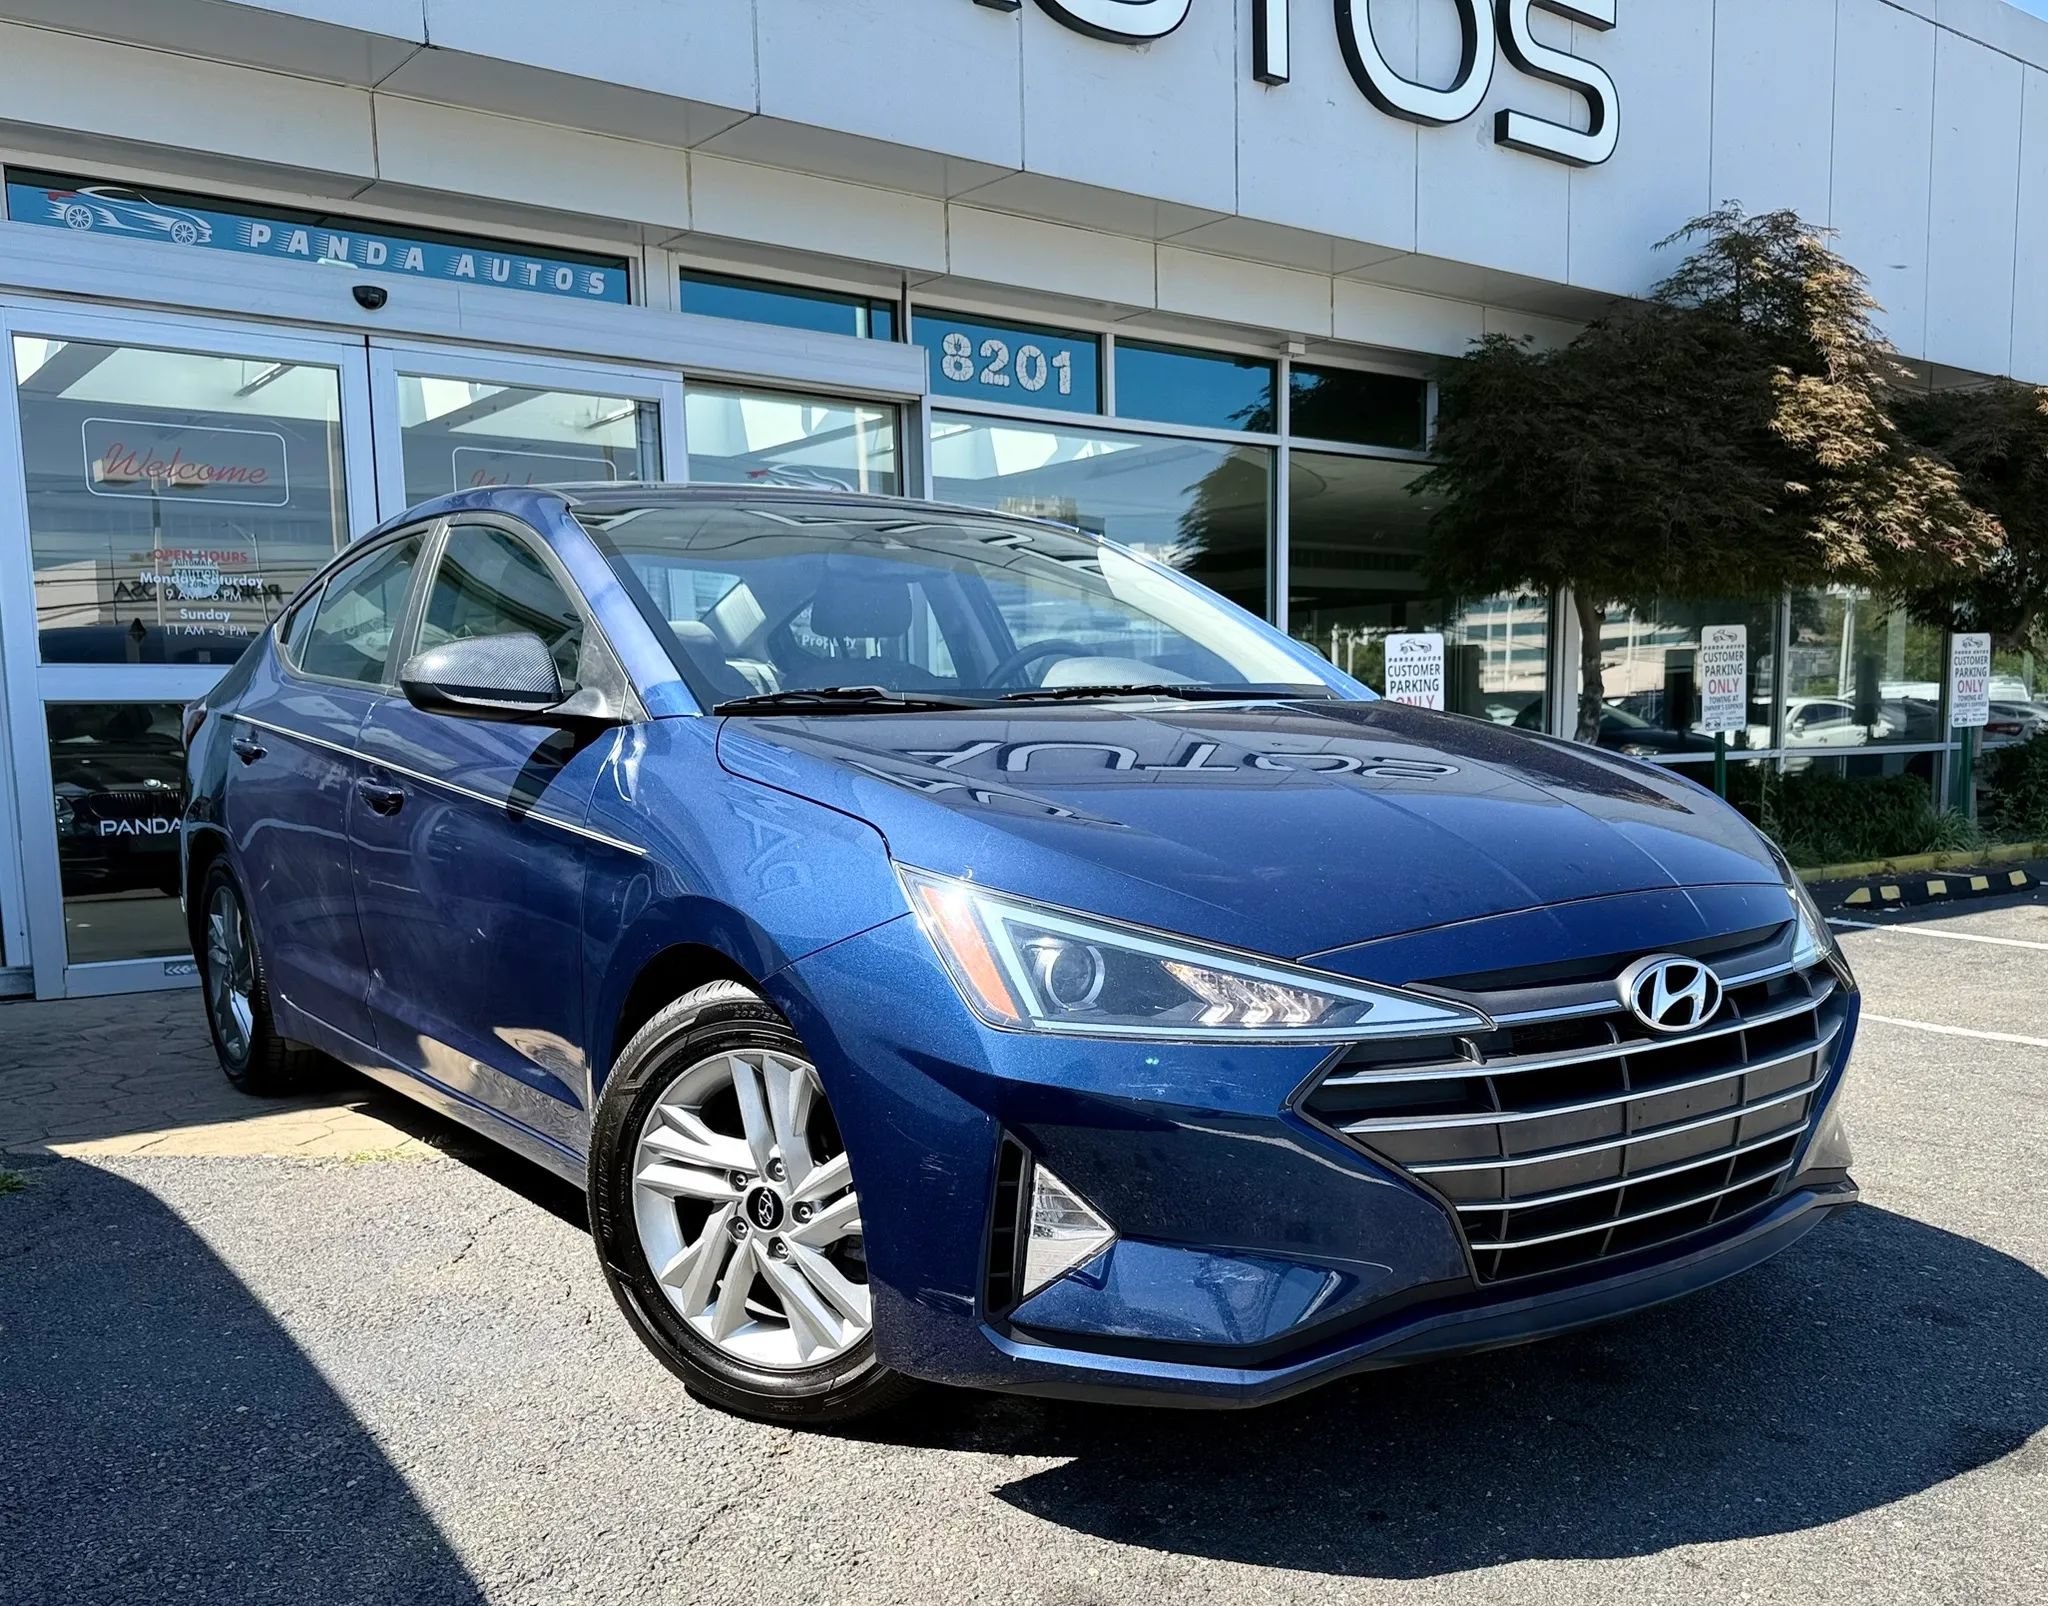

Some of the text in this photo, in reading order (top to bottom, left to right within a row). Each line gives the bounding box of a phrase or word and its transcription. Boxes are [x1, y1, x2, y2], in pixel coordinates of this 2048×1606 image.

[247, 222, 606, 296] PANDA AUTOS
[942, 332, 1071, 395] 8201
[106, 442, 269, 484] Welcome
[153, 548, 248, 562] OPEN HOURS
[165, 588, 174, 600] 9
[177, 590, 199, 601] AM
[211, 590, 219, 601] 6
[223, 590, 242, 601] PM
[179, 608, 231, 623] Sunday
[165, 625, 179, 636] 11
[184, 625, 206, 636] AM
[217, 625, 226, 636] 3
[229, 625, 249, 636] PM
[801, 634, 856, 650] Propty
[1703, 650, 1745, 663] CUSTOMER
[1953, 655, 1989, 666] CUSTOMER
[1387, 664, 1441, 678] CUSTOMER
[1704, 663, 1743, 678] PARKING
[1954, 666, 1988, 678] PARKING
[1389, 678, 1440, 694] PARKING
[1708, 678, 1740, 695] ONLY
[1957, 679, 1984, 694] ONLY
[100, 817, 181, 836] PANDA
